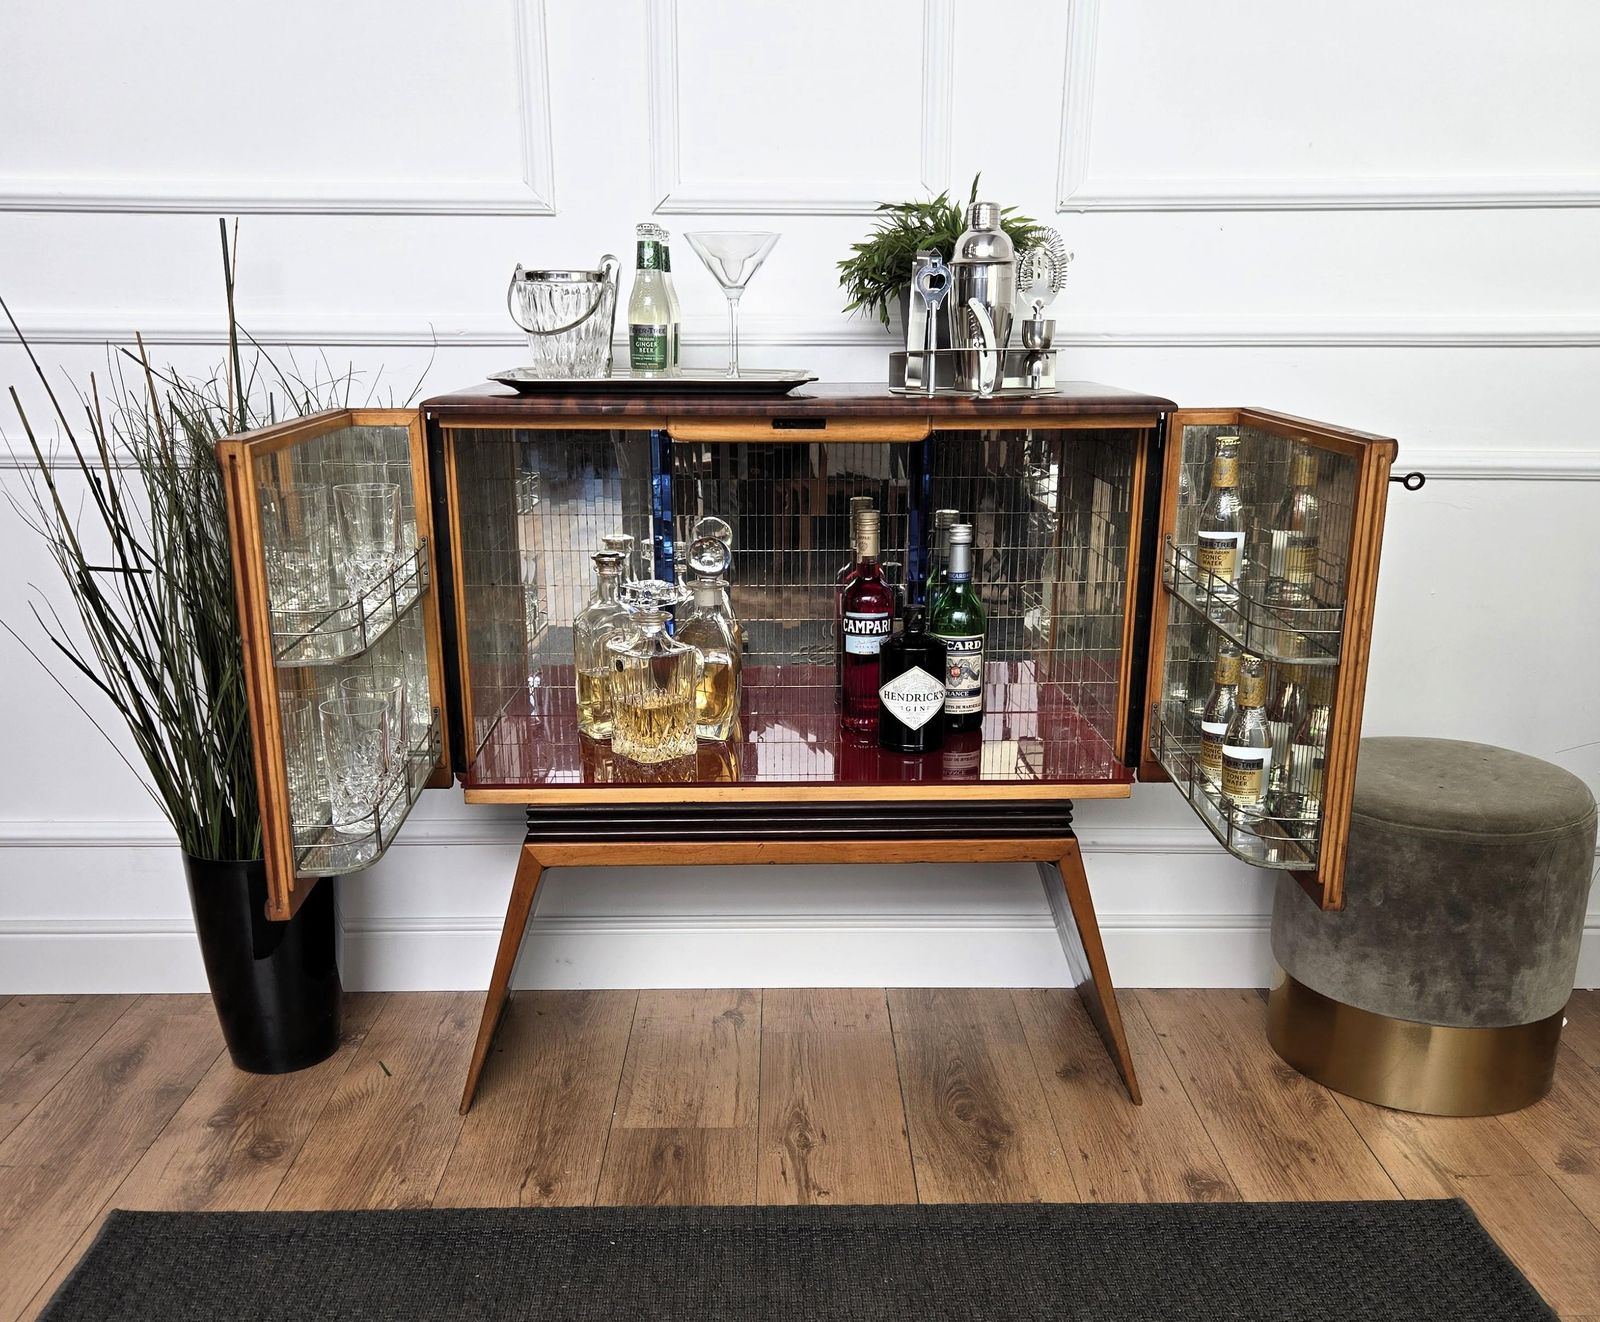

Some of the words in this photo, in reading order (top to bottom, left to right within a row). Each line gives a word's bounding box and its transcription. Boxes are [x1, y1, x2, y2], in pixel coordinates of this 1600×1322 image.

[842, 618, 891, 634] CAMPARI
[946, 640, 982, 651] CARD
[884, 690, 944, 702] HENDRICK'S
[1226, 772, 1248, 781] TONIC
[1226, 779, 1248, 787] WATER
